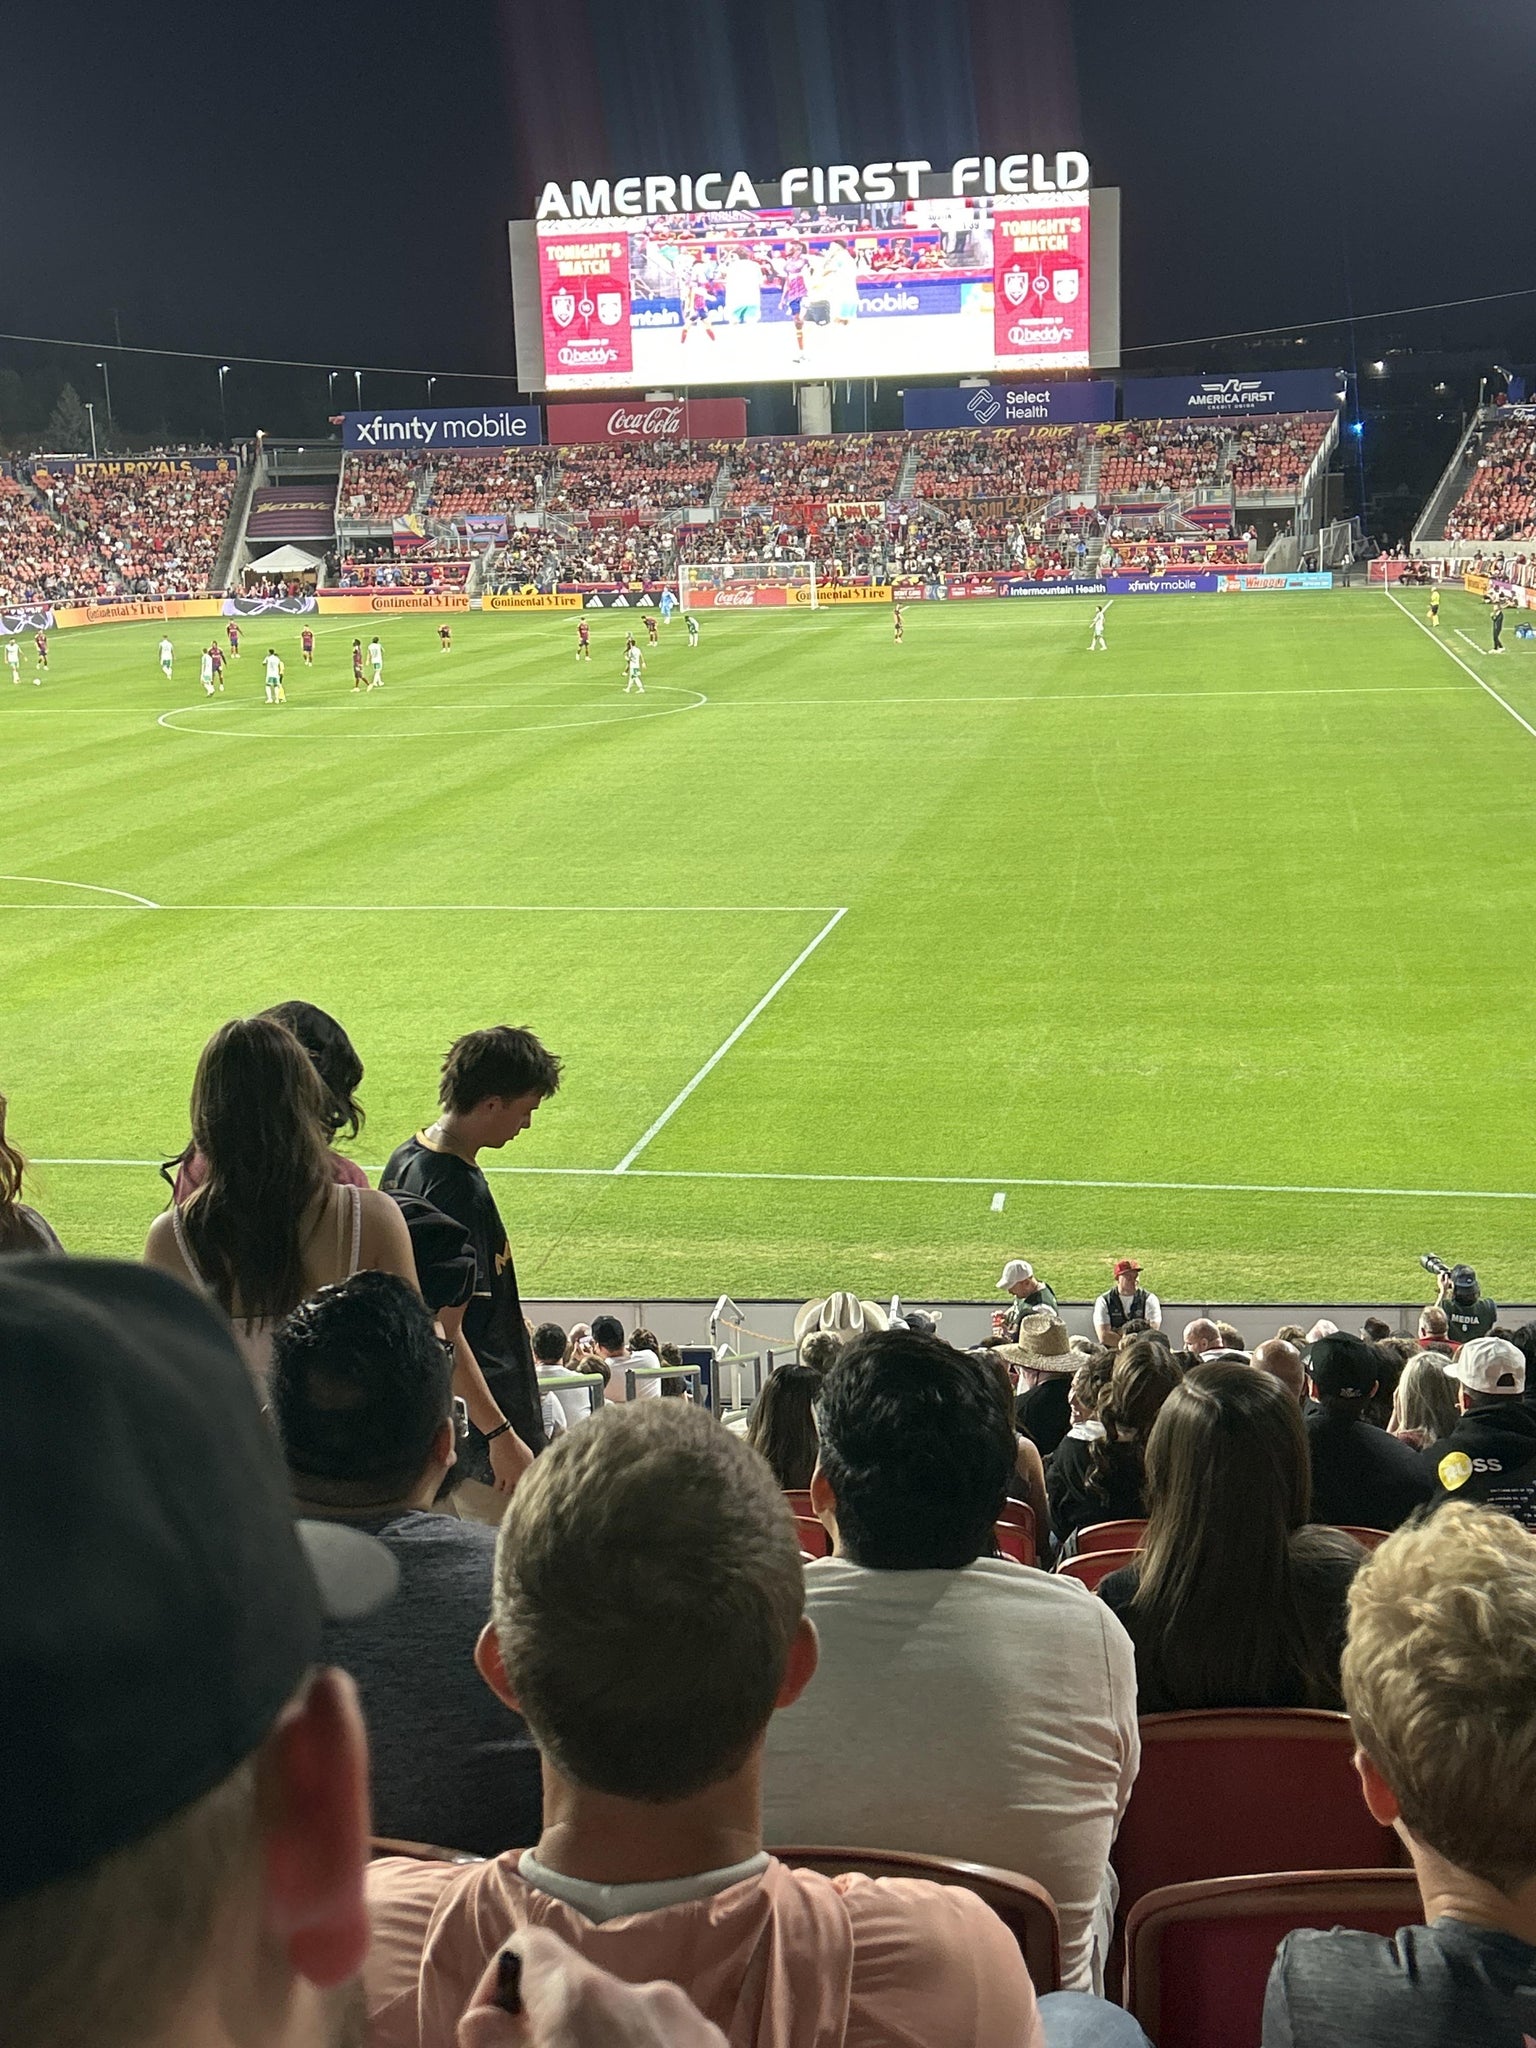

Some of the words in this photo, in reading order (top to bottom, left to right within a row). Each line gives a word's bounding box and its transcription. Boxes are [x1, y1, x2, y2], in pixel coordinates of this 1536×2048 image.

[536, 171, 761, 220] AMERICA
[780, 160, 931, 206] FIRST
[952, 151, 1089, 196] FIELD
[1000, 217, 1081, 237] TONIGHT'S
[1014, 234, 1069, 252] MATCH
[545, 242, 622, 261] TONIGHT'S
[557, 259, 611, 276] MATCH
[1006, 390, 1051, 404] Select
[1188, 393, 1240, 405] AMERICA
[1241, 391, 1275, 403] FIRST
[1006, 405, 1048, 419] Health
[357, 416, 438, 444] xfinity
[443, 413, 527, 438] mobile
[606, 406, 685, 436] Coca-Cola
[74, 462, 121, 475] UTAH
[124, 460, 192, 475] ROYALS
[1010, 585, 1074, 596] Intermountain
[1075, 583, 1106, 594] Health
[1128, 580, 1160, 592] xfinity
[1161, 579, 1197, 590] mobile
[371, 596, 432, 611] Continental
[442, 595, 469, 607] Tire
[490, 595, 545, 609] Continental
[553, 595, 576, 606] Tire
[714, 590, 756, 606] Coca-Cola
[796, 589, 852, 603] Coninental
[862, 588, 885, 598] Tire
[140, 603, 164, 615] Tire
[1451, 1313, 1480, 1325] MEDIA
